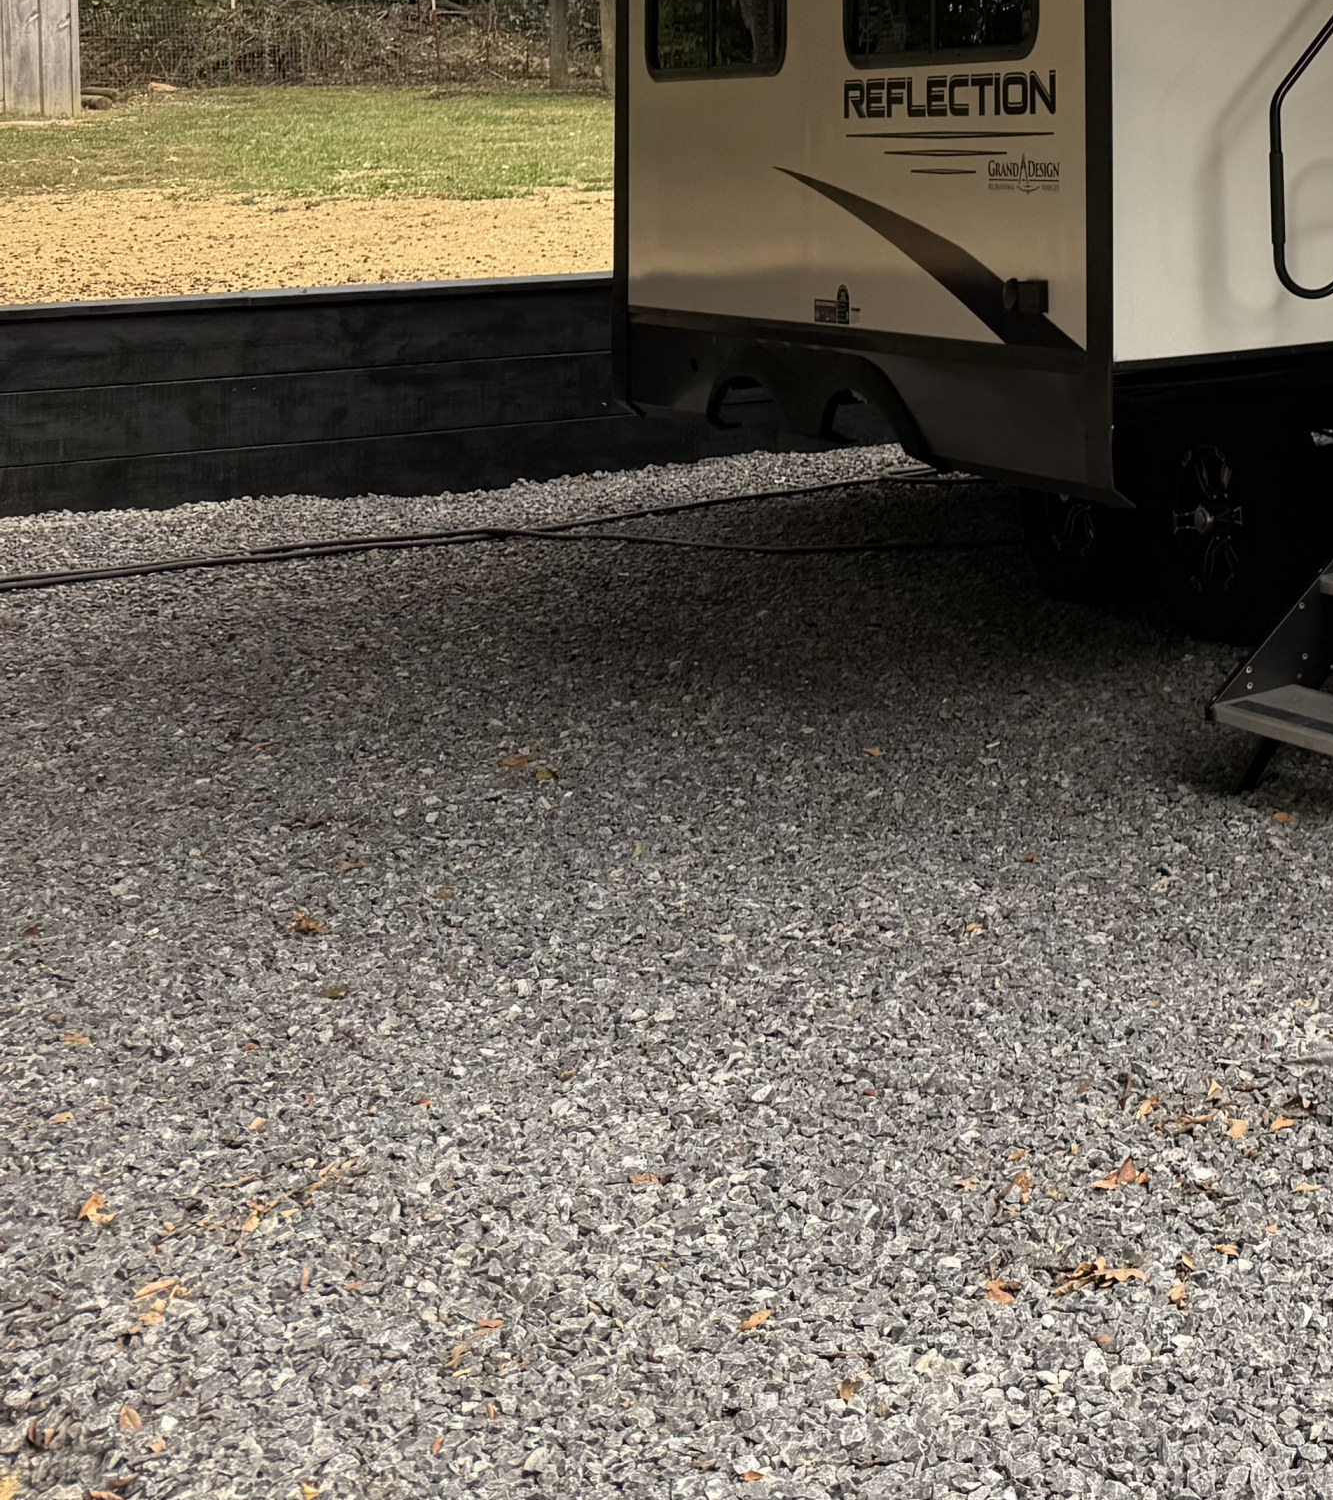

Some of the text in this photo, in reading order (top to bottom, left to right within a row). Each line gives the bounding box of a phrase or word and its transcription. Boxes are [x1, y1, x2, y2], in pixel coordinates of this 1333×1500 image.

[843, 69, 1057, 119] REFLECTION
[988, 159, 1061, 178] GRAND DESIGN
